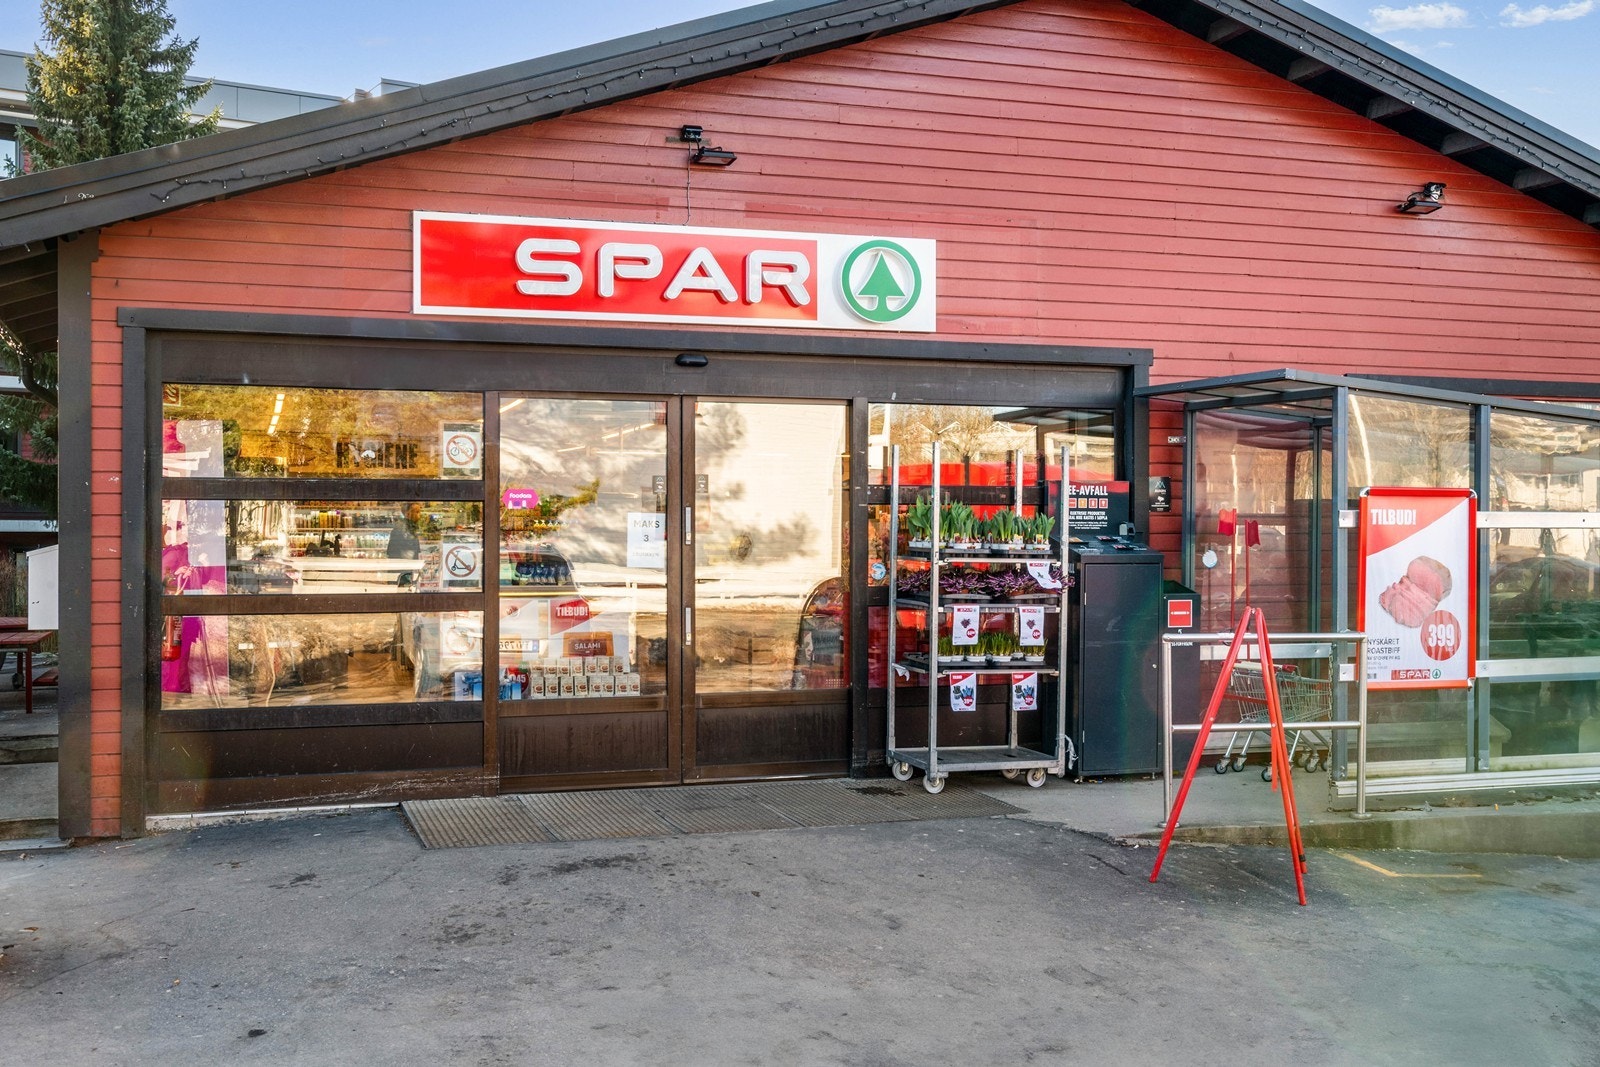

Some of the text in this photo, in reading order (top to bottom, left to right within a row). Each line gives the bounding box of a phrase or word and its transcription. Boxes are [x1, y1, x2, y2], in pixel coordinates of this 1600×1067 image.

[514, 237, 811, 306] SPAR
[1371, 509, 1416, 525] TILBUD!
[633, 520, 660, 528] MAKS
[643, 534, 650, 542] 3
[556, 606, 588, 617] TILBUD!
[1428, 624, 1455, 647] 399
[1400, 670, 1430, 679] SPAR
